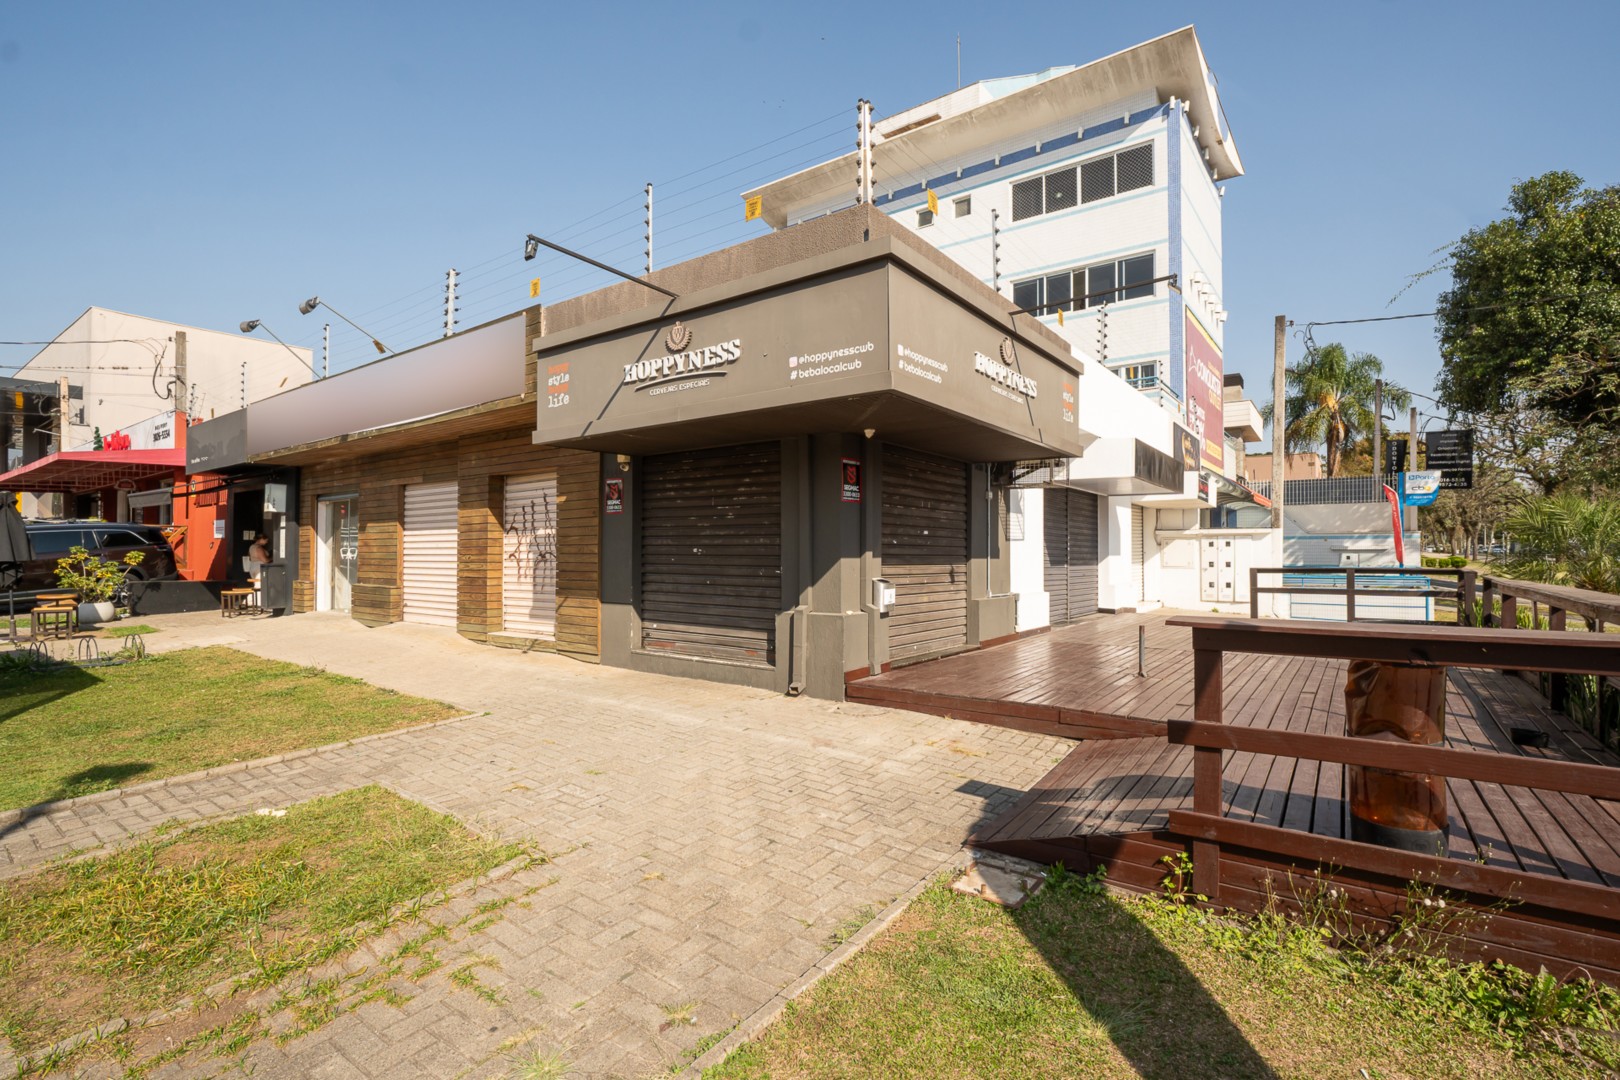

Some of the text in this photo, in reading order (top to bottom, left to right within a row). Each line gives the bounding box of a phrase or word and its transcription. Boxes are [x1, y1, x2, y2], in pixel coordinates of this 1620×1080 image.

[623, 339, 741, 383] HOPPYNESS
[799, 341, 875, 365] @hoppynesscwb
[548, 373, 570, 386] style
[650, 378, 710, 396] CERVEJAS ESPECIAIS
[548, 393, 570, 408] life
